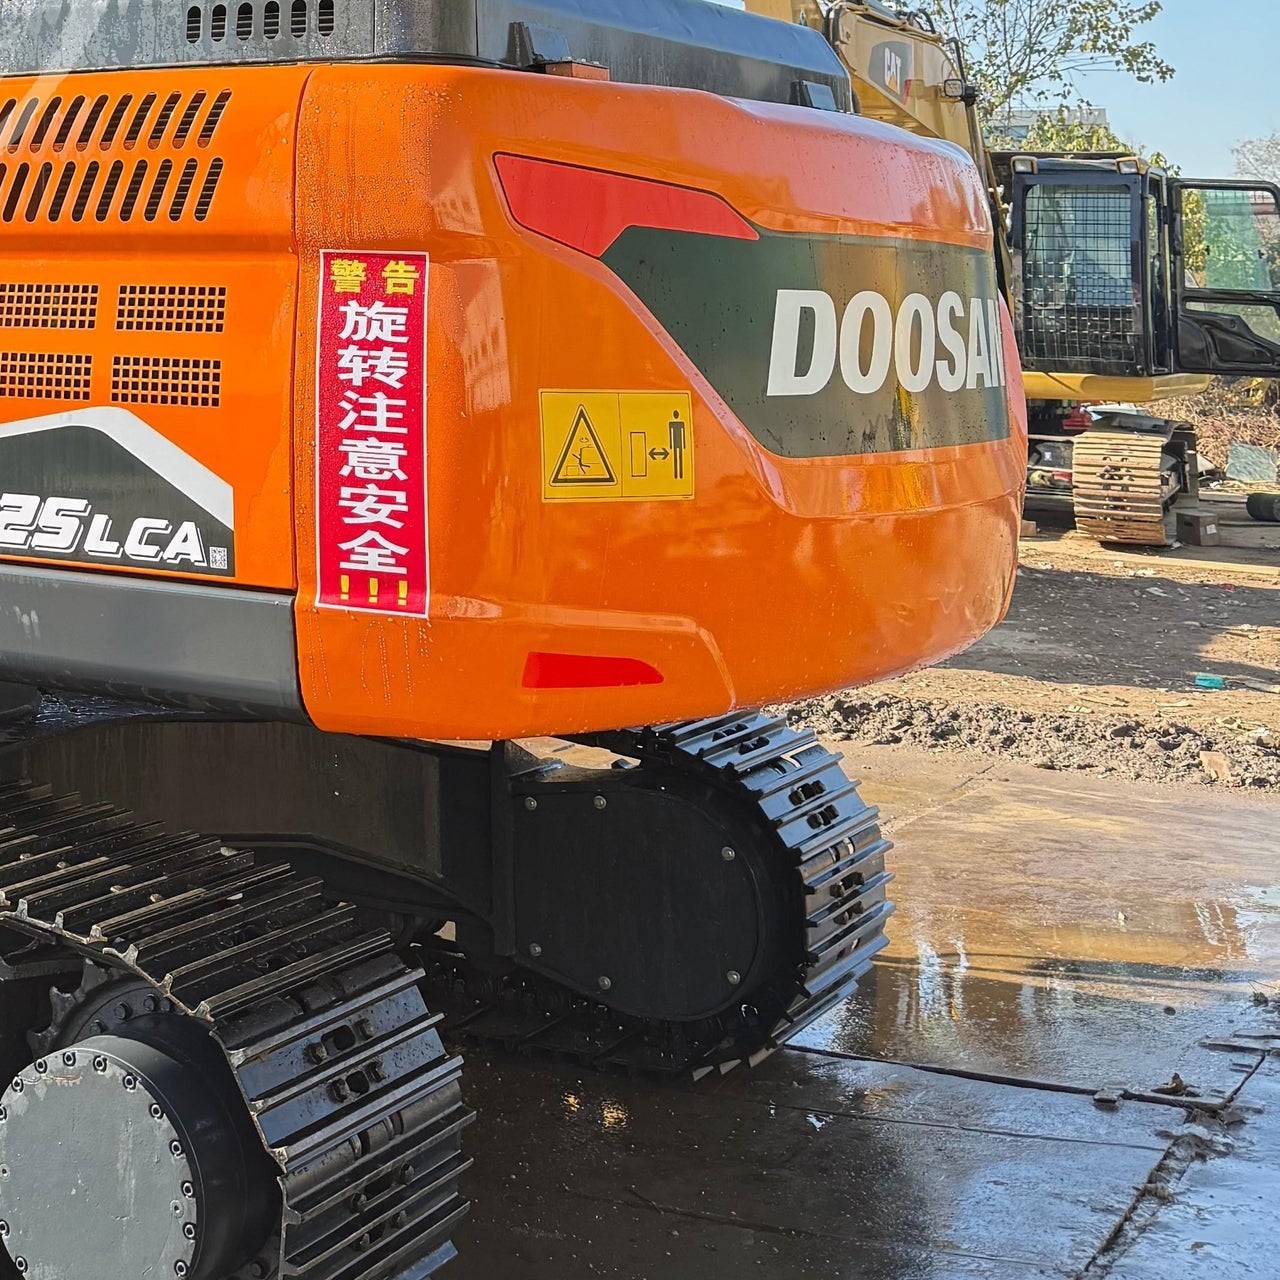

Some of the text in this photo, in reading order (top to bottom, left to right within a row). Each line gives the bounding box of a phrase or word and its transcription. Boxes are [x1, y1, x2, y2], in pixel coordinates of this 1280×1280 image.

[884, 47, 902, 95] CAT
[329, 259, 420, 295] 警告
[766, 288, 1006, 397] DOOSAN
[338, 300, 410, 575] 旋转注意安全
